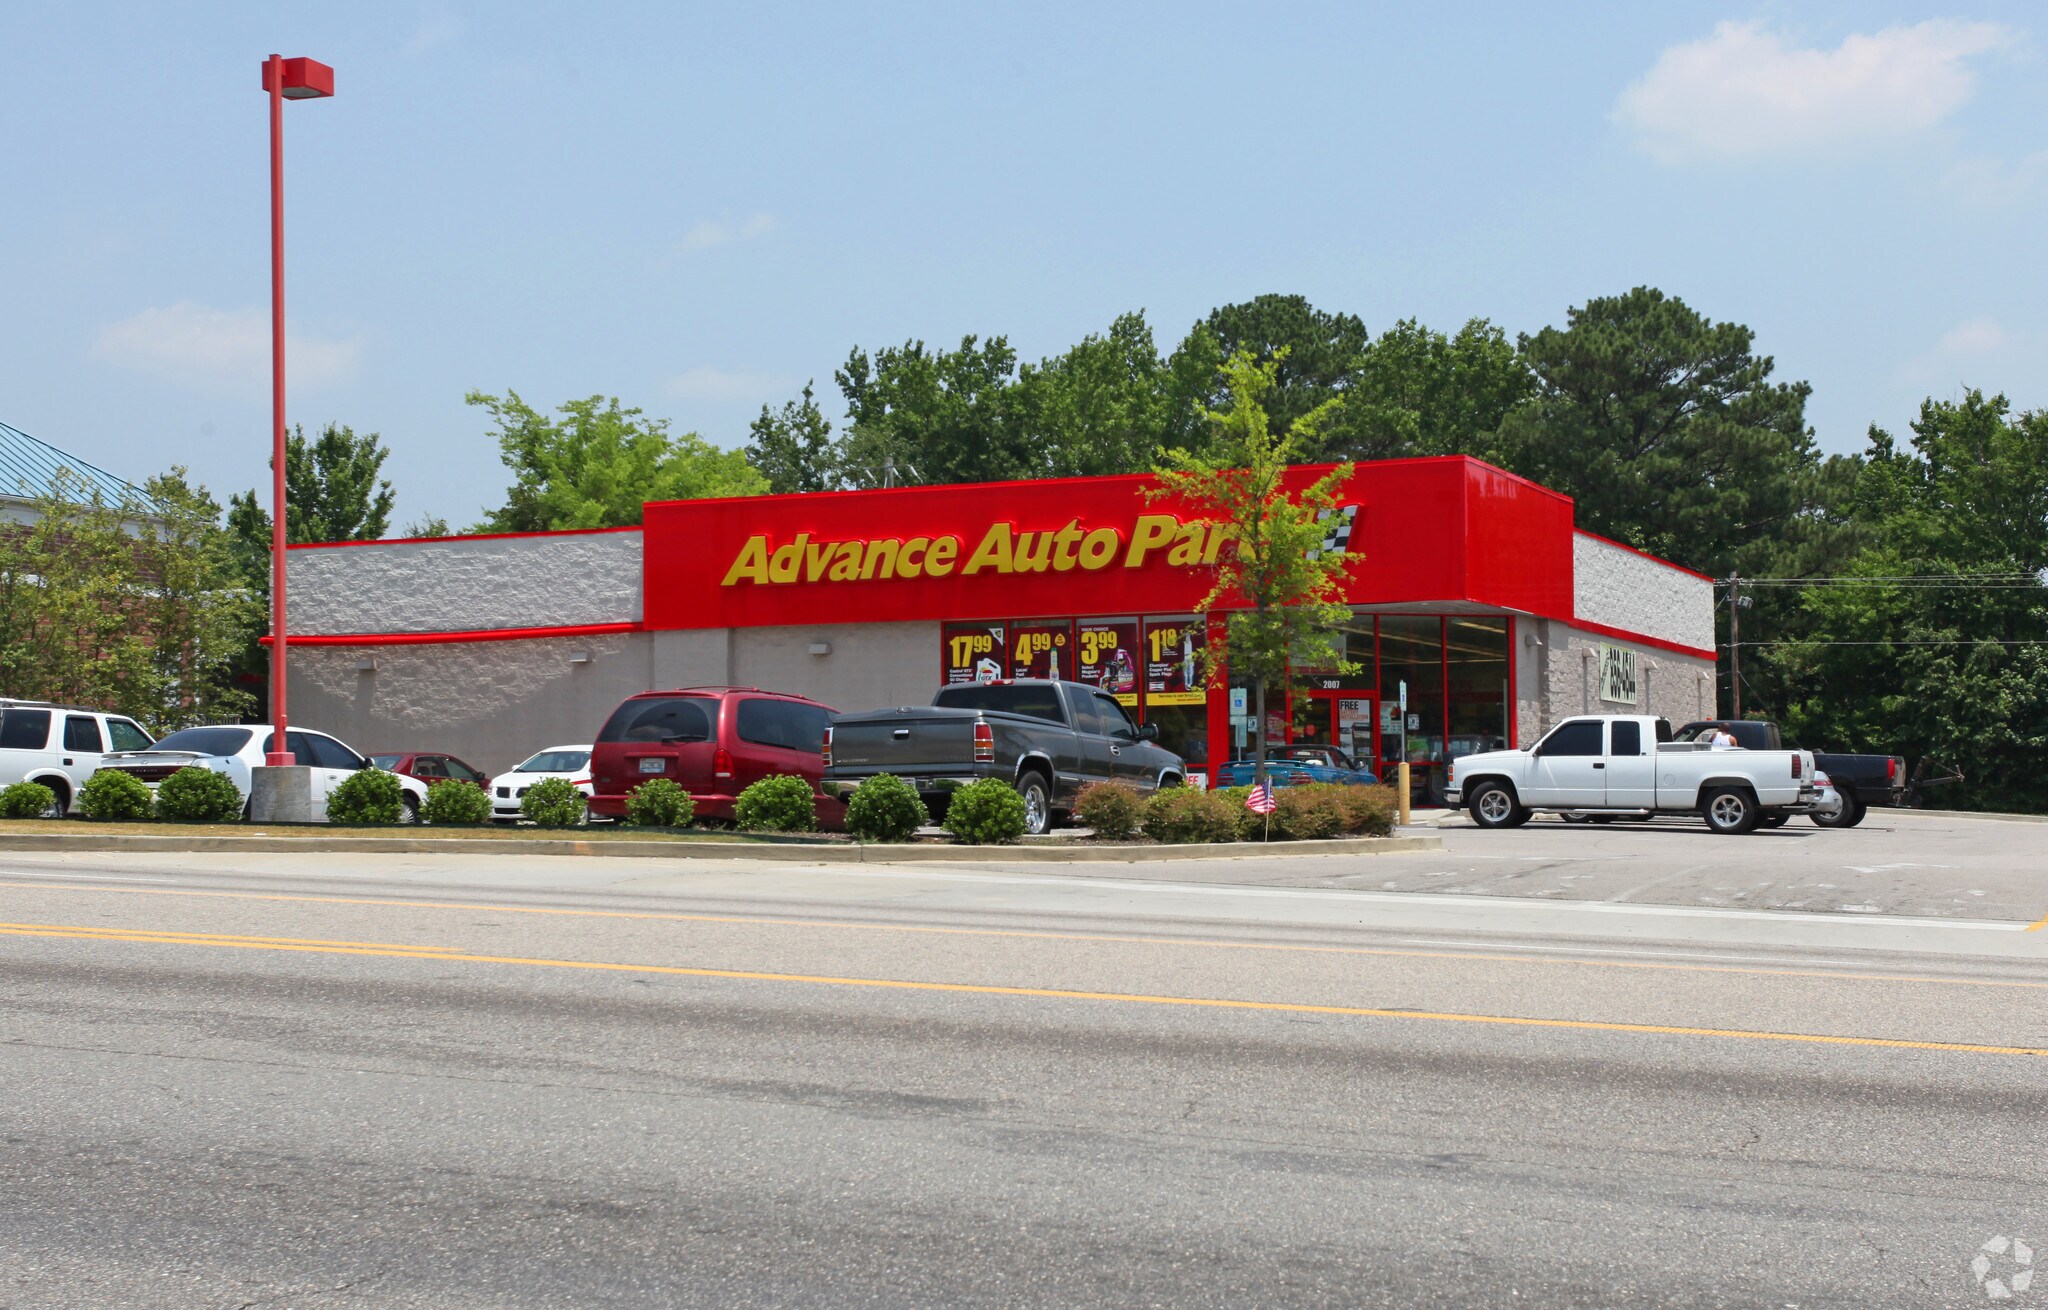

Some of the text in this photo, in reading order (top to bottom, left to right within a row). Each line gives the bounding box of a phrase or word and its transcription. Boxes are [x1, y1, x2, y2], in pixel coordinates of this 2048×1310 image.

[721, 532, 960, 587] Advance
[961, 519, 1125, 575] Auto
[1323, 680, 1340, 689] 2007
[1340, 701, 1359, 710] FREE
